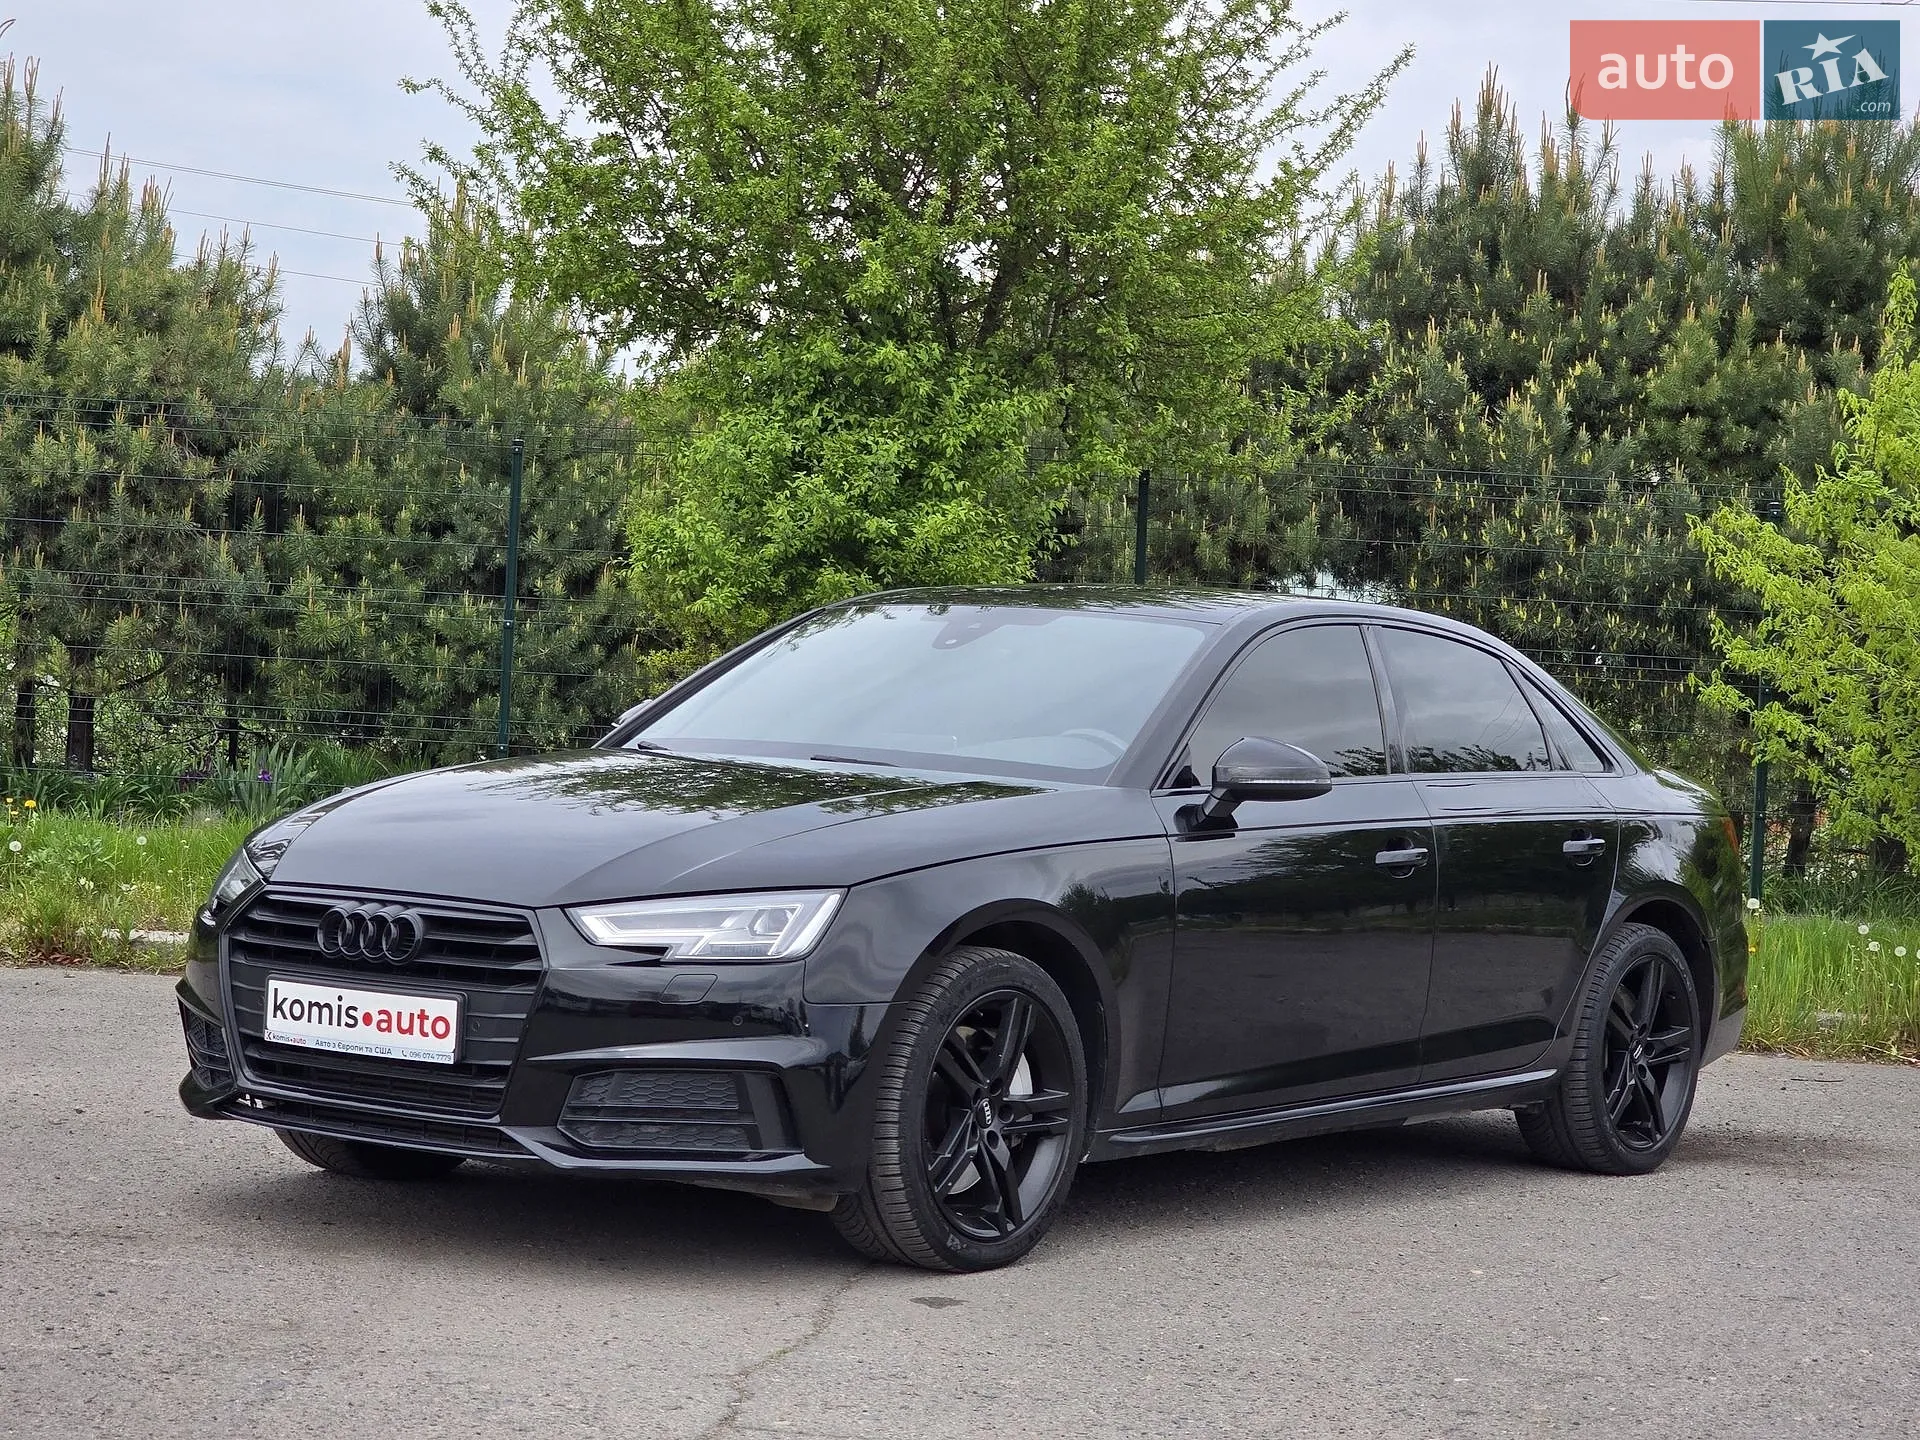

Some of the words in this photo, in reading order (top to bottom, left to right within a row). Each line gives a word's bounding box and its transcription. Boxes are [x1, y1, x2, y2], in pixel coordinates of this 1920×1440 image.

[315, 1039, 331, 1048] Авто
[337, 1042, 363, 1053] Європи
[374, 1046, 393, 1056] США
